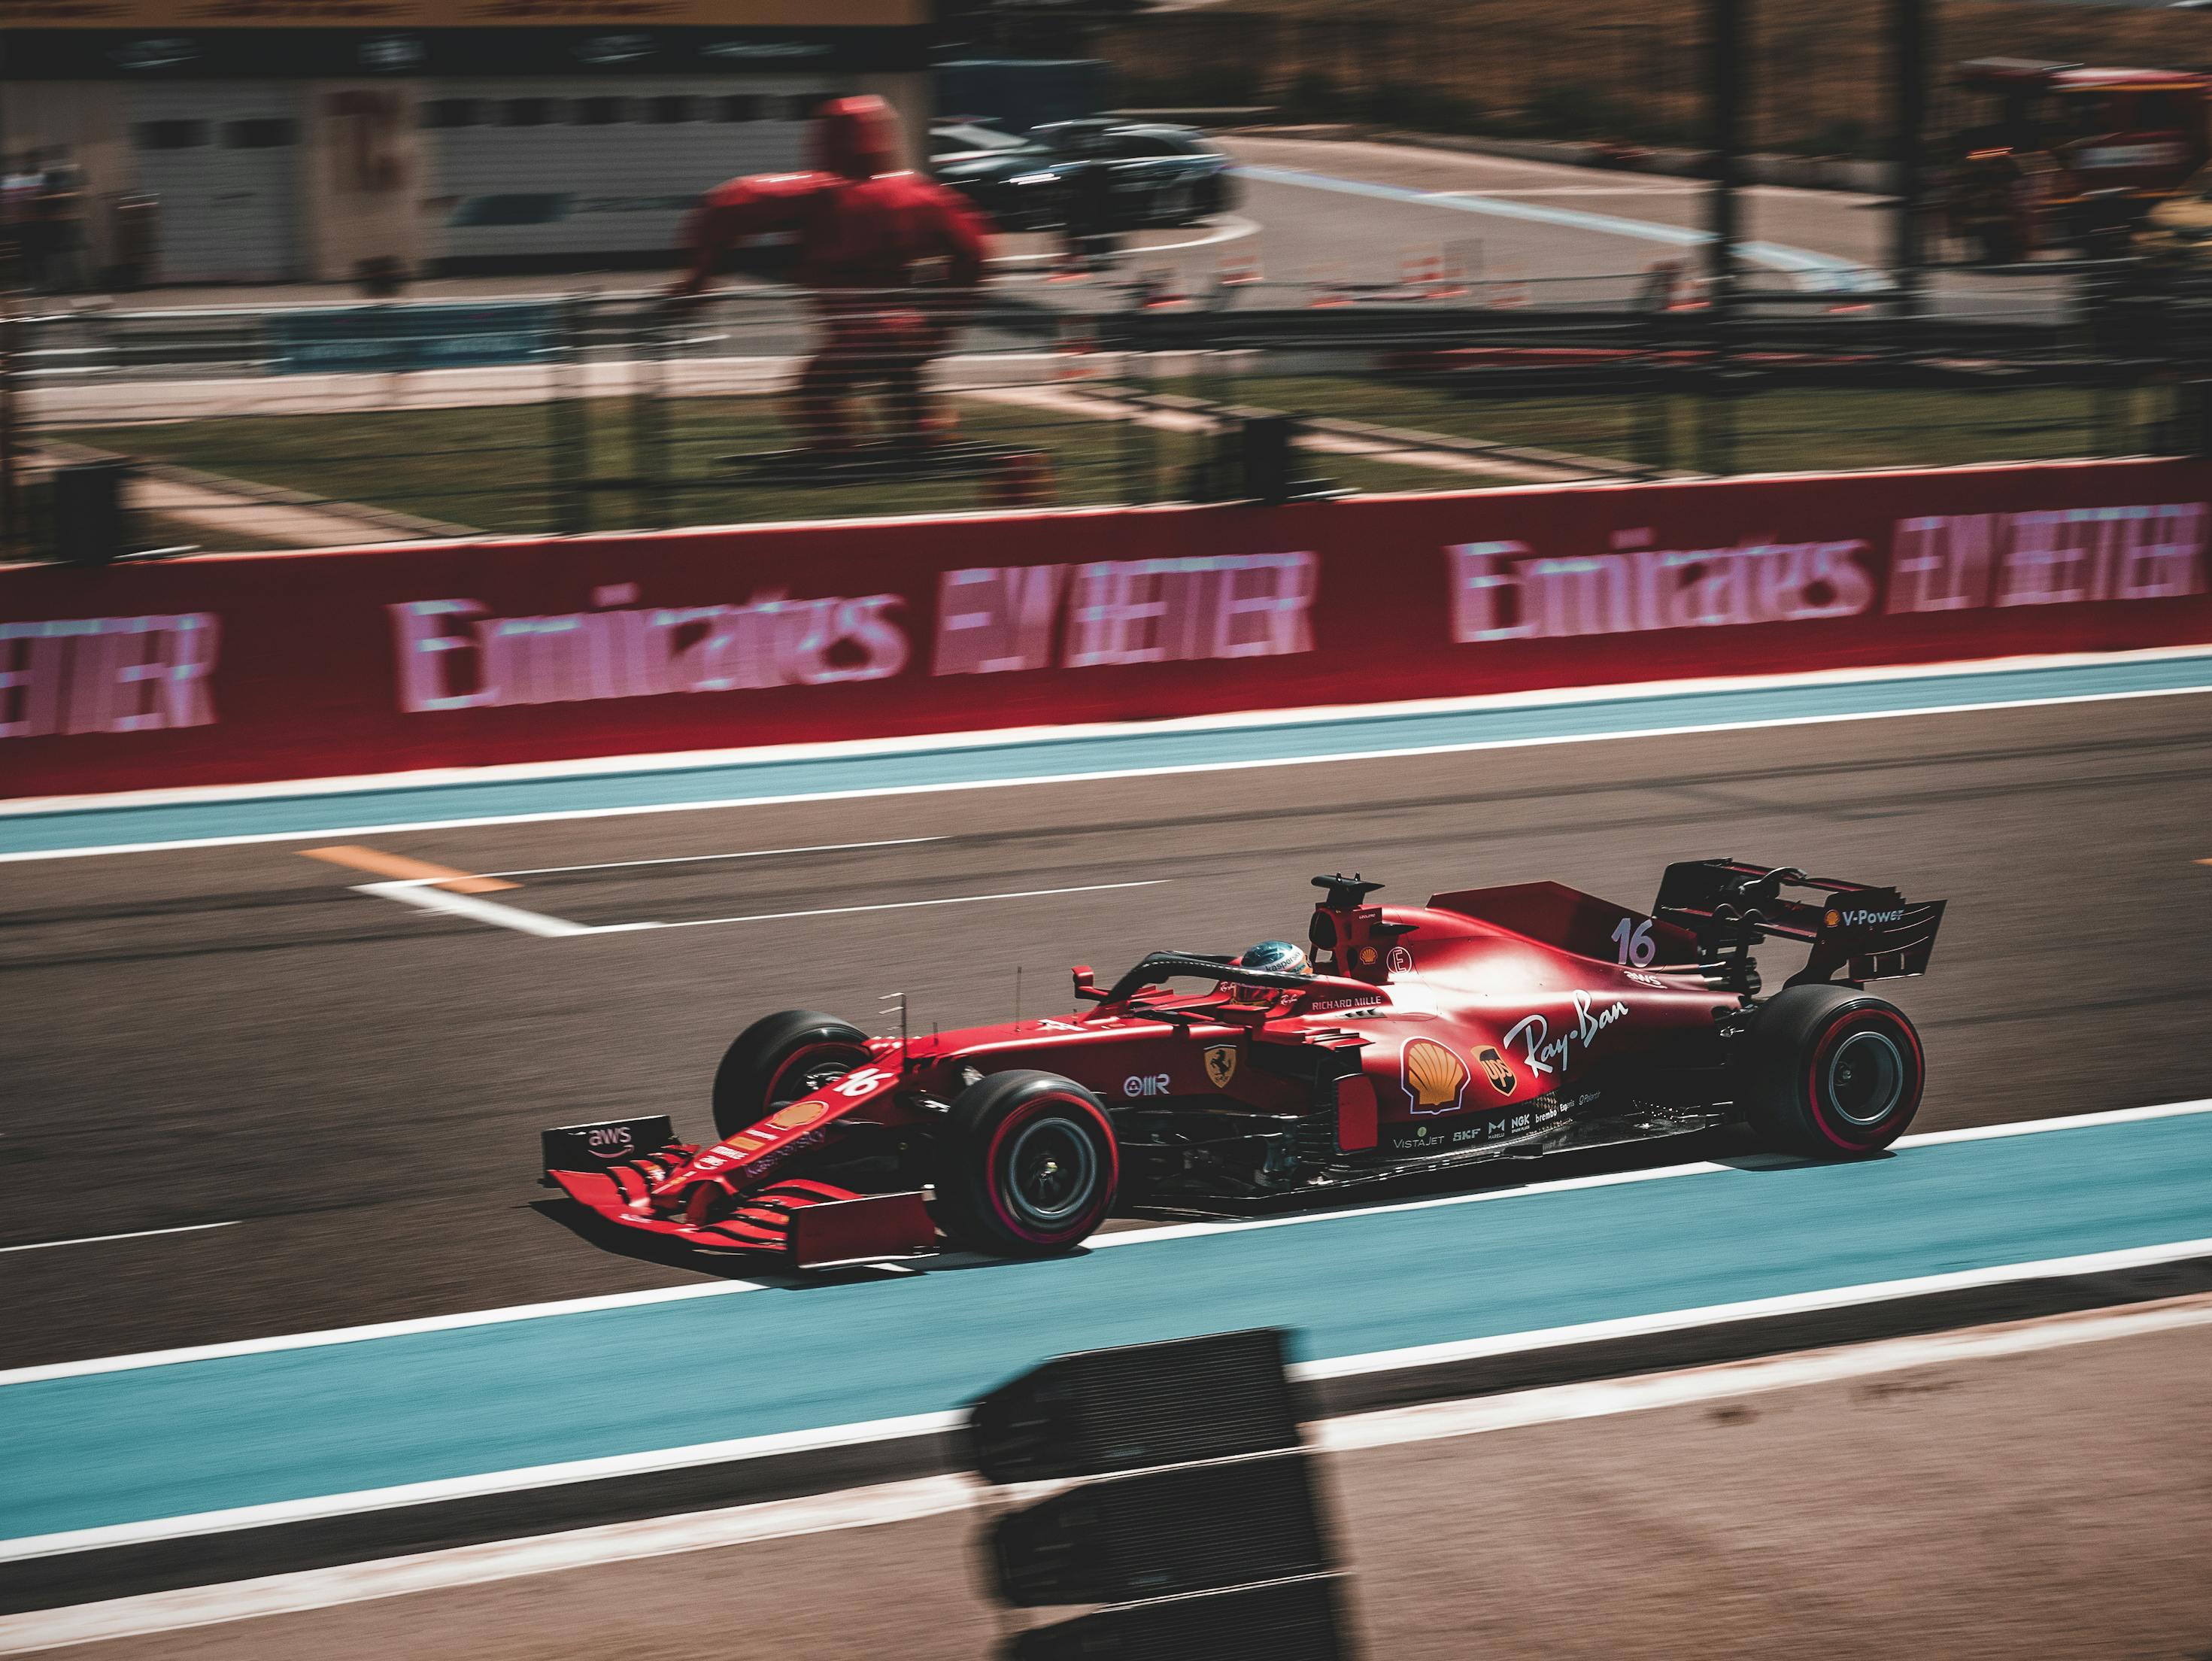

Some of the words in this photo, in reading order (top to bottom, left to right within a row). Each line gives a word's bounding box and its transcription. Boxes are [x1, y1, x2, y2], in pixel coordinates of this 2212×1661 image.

[1444, 527, 1876, 643] Emirates
[390, 581, 907, 712] Emirates
[1843, 909, 1904, 926] V-Power
[1611, 918, 1655, 968] 16
[1624, 970, 1661, 985] aws
[1312, 999, 1352, 1010] RICHARD
[1355, 996, 1381, 1006] MILLE
[833, 1068, 894, 1096] 16
[1481, 1059, 1512, 1087] ups
[1511, 1113, 1530, 1128] NGK
[1535, 1109, 1557, 1123] brembo
[588, 1127, 631, 1146] aws
[1452, 1128, 1481, 1142] SKF
